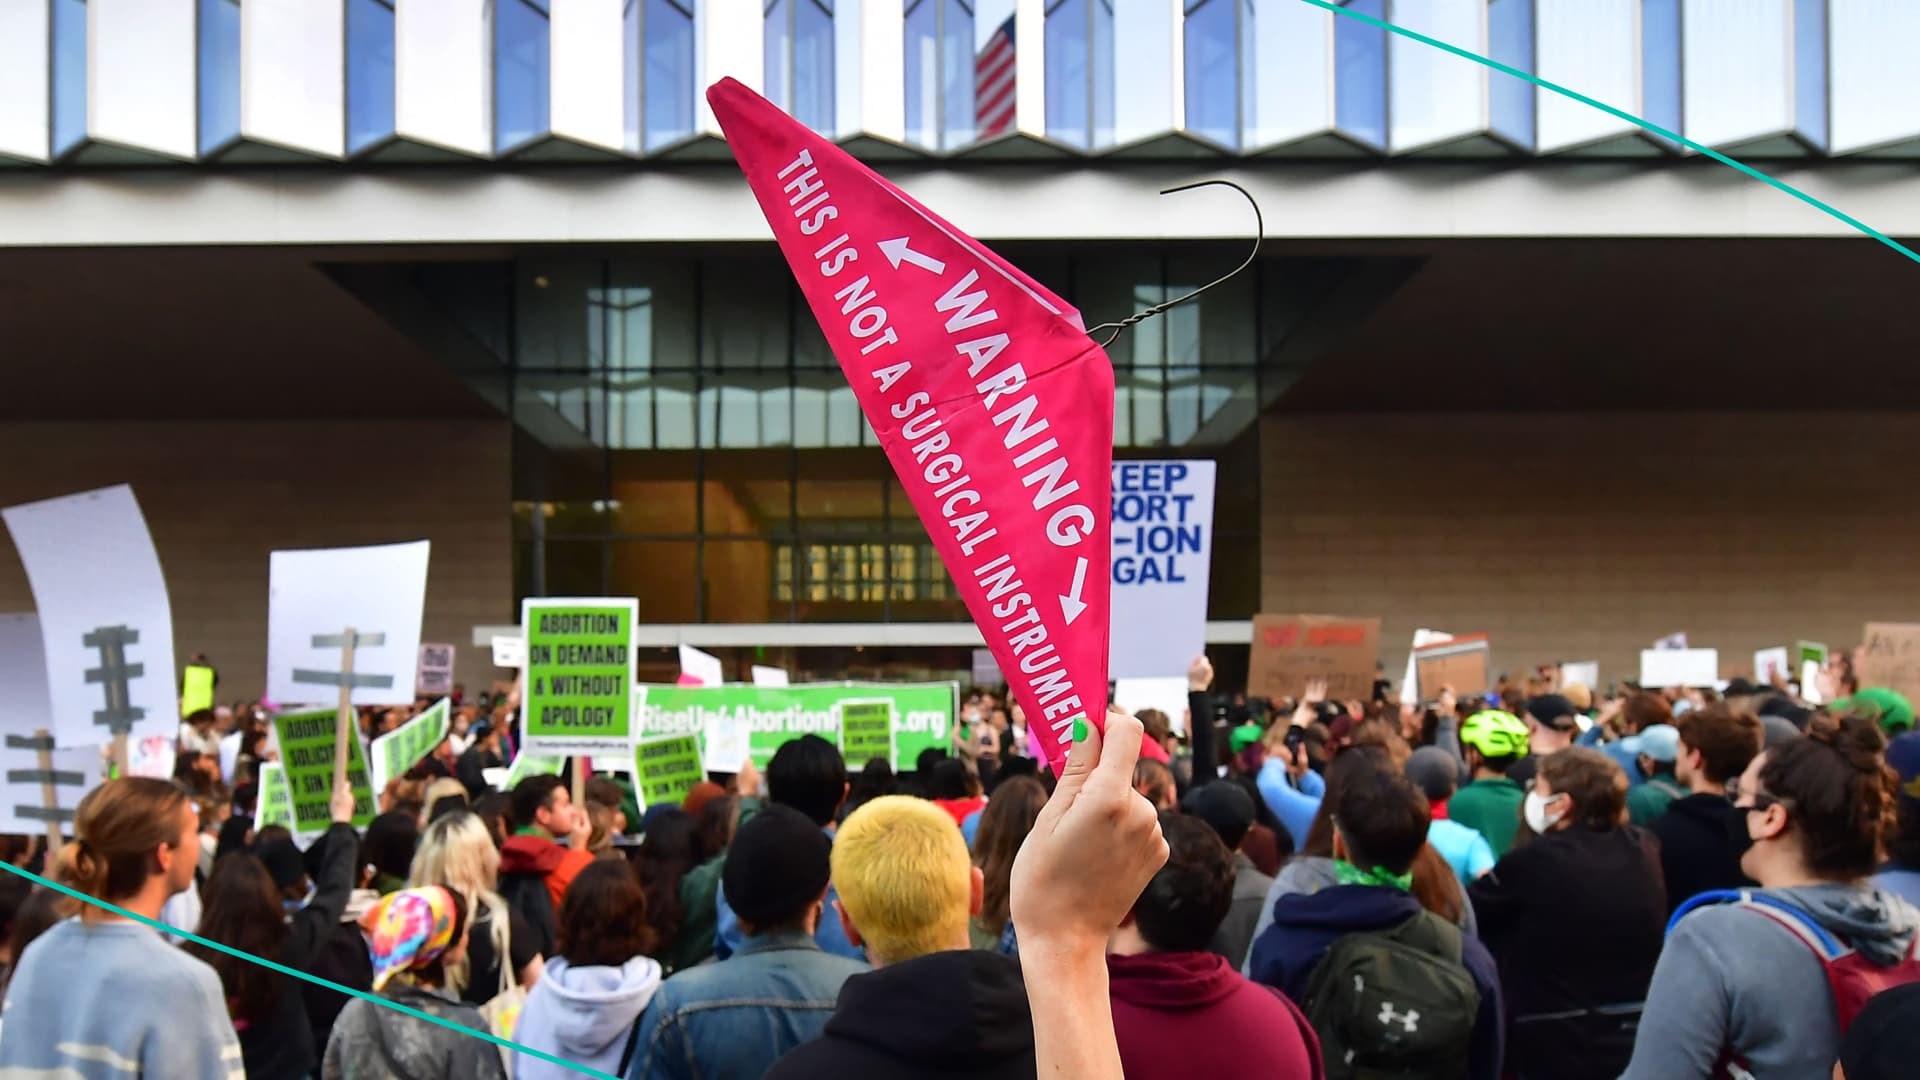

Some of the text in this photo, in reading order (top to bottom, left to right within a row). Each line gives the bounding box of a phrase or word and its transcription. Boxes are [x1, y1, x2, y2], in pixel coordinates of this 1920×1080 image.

[935, 269, 1095, 547] WARNING
[777, 148, 1090, 758] THIS IS NOT A SURGICAL INSTRUMEN
[540, 613, 619, 635] ABORTION
[530, 645, 551, 665] ON
[557, 644, 628, 665] DEMAND
[551, 675, 622, 696] WITHOUT
[542, 706, 615, 727] APOLOGY
